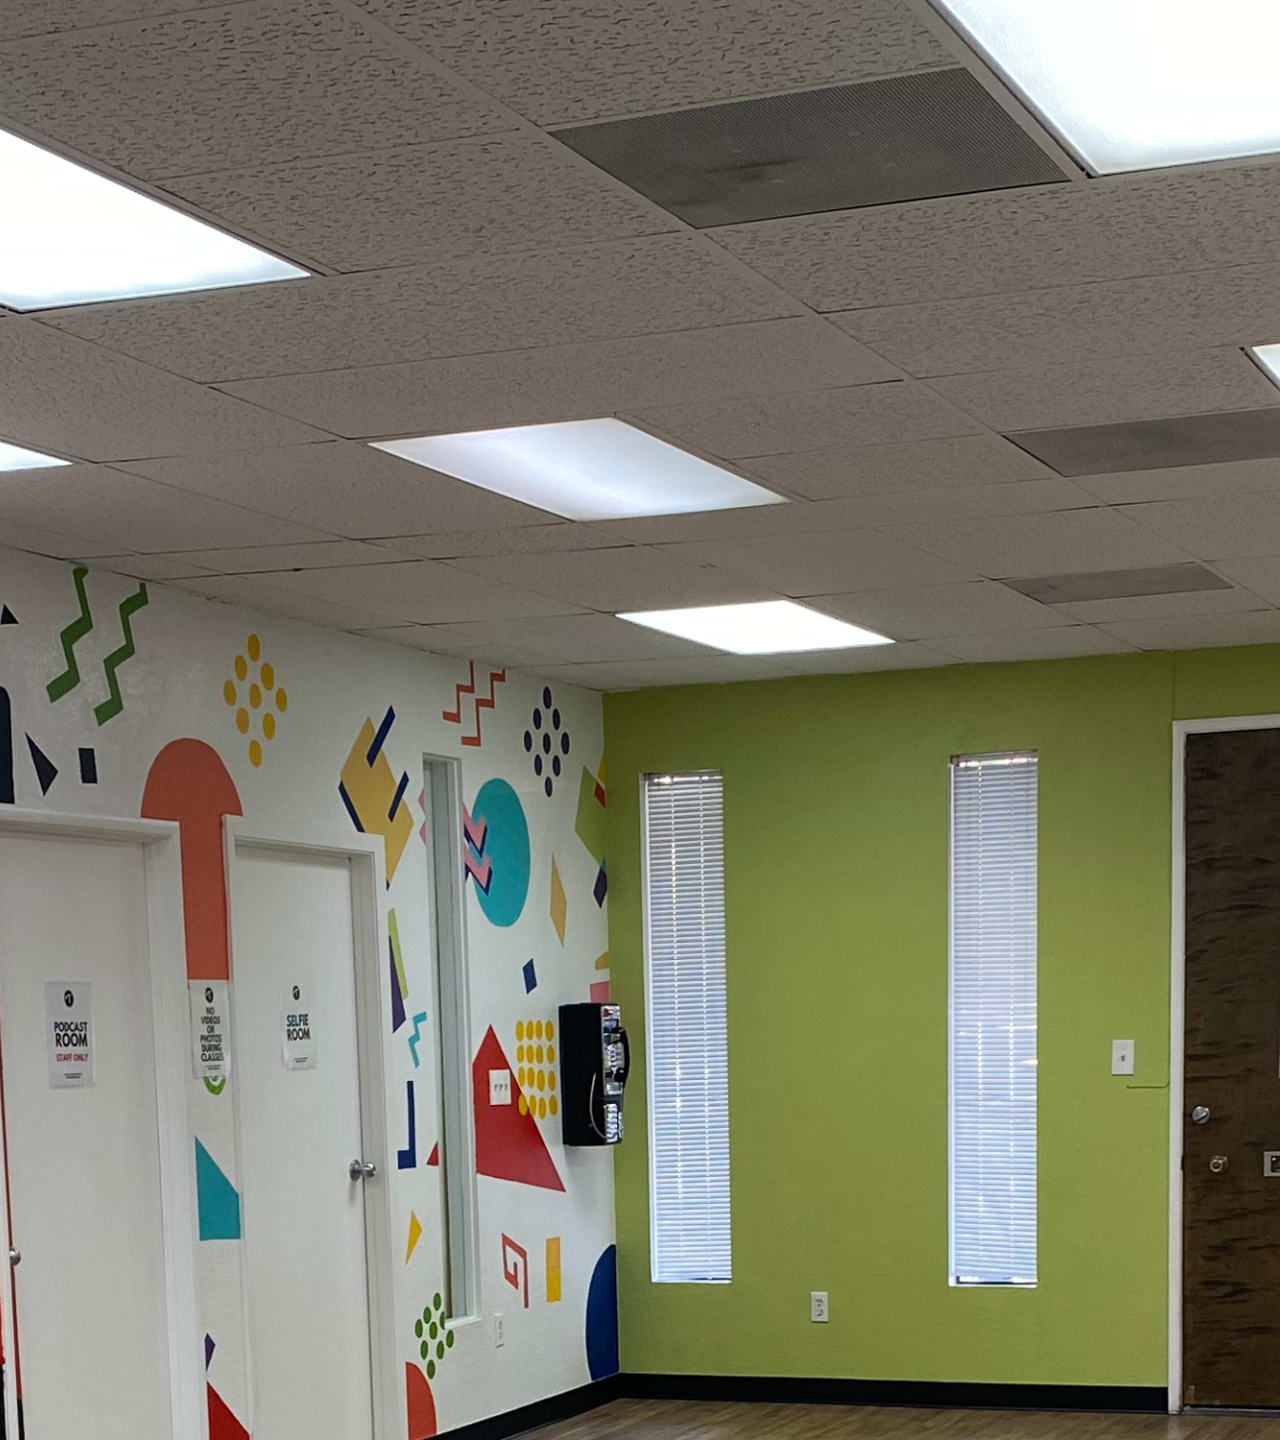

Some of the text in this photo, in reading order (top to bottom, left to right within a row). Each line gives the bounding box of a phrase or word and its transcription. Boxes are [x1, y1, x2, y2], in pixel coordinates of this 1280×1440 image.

[206, 1007, 215, 1015] NO
[201, 1016, 221, 1024] VIDEOS
[286, 1014, 308, 1027] SELFIE
[54, 1021, 88, 1032] PODCAST
[200, 1034, 222, 1042] PHOTOS
[287, 1028, 311, 1041] ROOM
[55, 1033, 88, 1047] ROOM
[201, 1044, 222, 1052] DURING
[56, 1053, 88, 1062] STAFF ONLY
[200, 1053, 224, 1062] CLASSES
